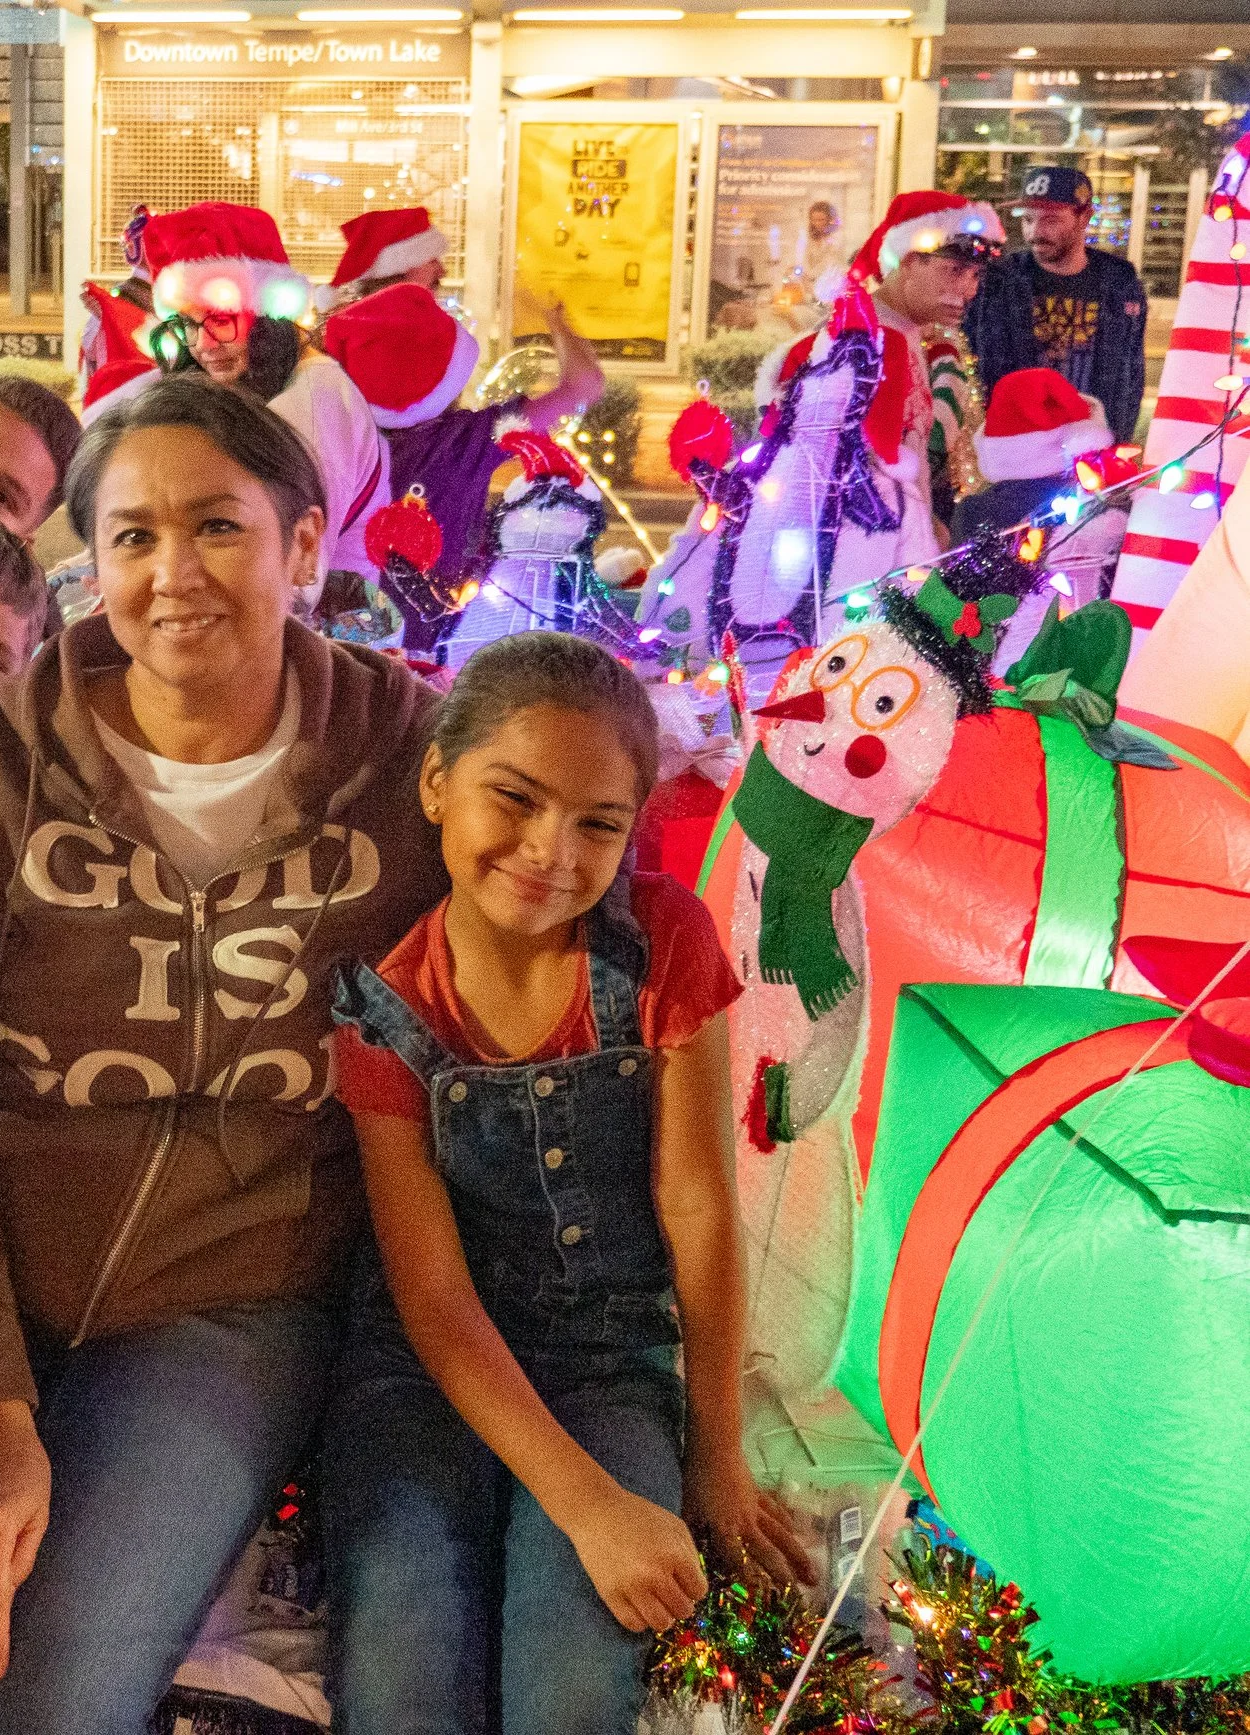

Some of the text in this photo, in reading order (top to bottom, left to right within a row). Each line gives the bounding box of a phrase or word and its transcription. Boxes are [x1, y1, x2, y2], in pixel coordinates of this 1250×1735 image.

[124, 39, 441, 67] Downtown Tempe/Town Lake
[573, 140, 614, 156] LIVE
[575, 161, 619, 176] RIDE
[567, 182, 630, 196] ANOTHER
[573, 197, 622, 218] DAY
[21, 820, 381, 915] GOD
[125, 924, 309, 1021] IS
